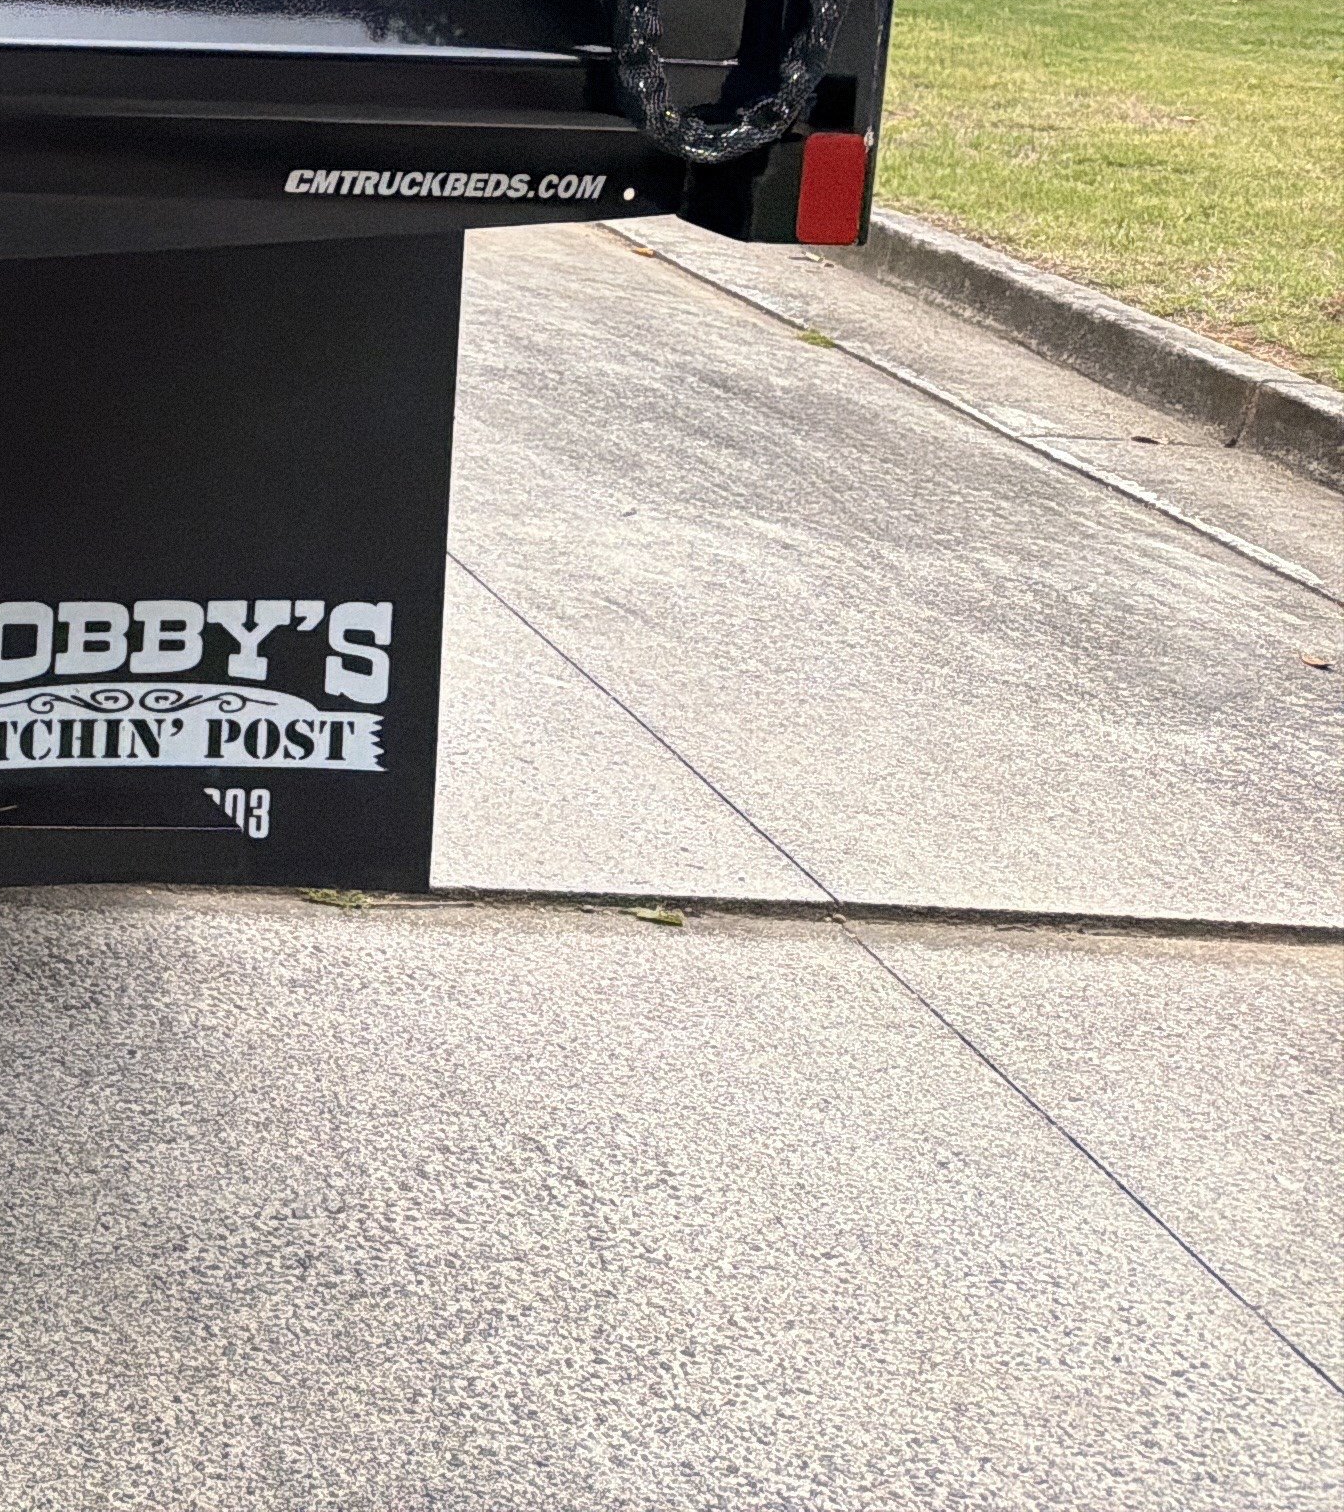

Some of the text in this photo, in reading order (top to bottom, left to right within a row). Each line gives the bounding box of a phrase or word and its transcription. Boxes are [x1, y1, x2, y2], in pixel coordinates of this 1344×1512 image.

[284, 169, 607, 200] CMTRUCKBEDS.COM
[203, 718, 355, 762] POST
[203, 788, 271, 839] 03
